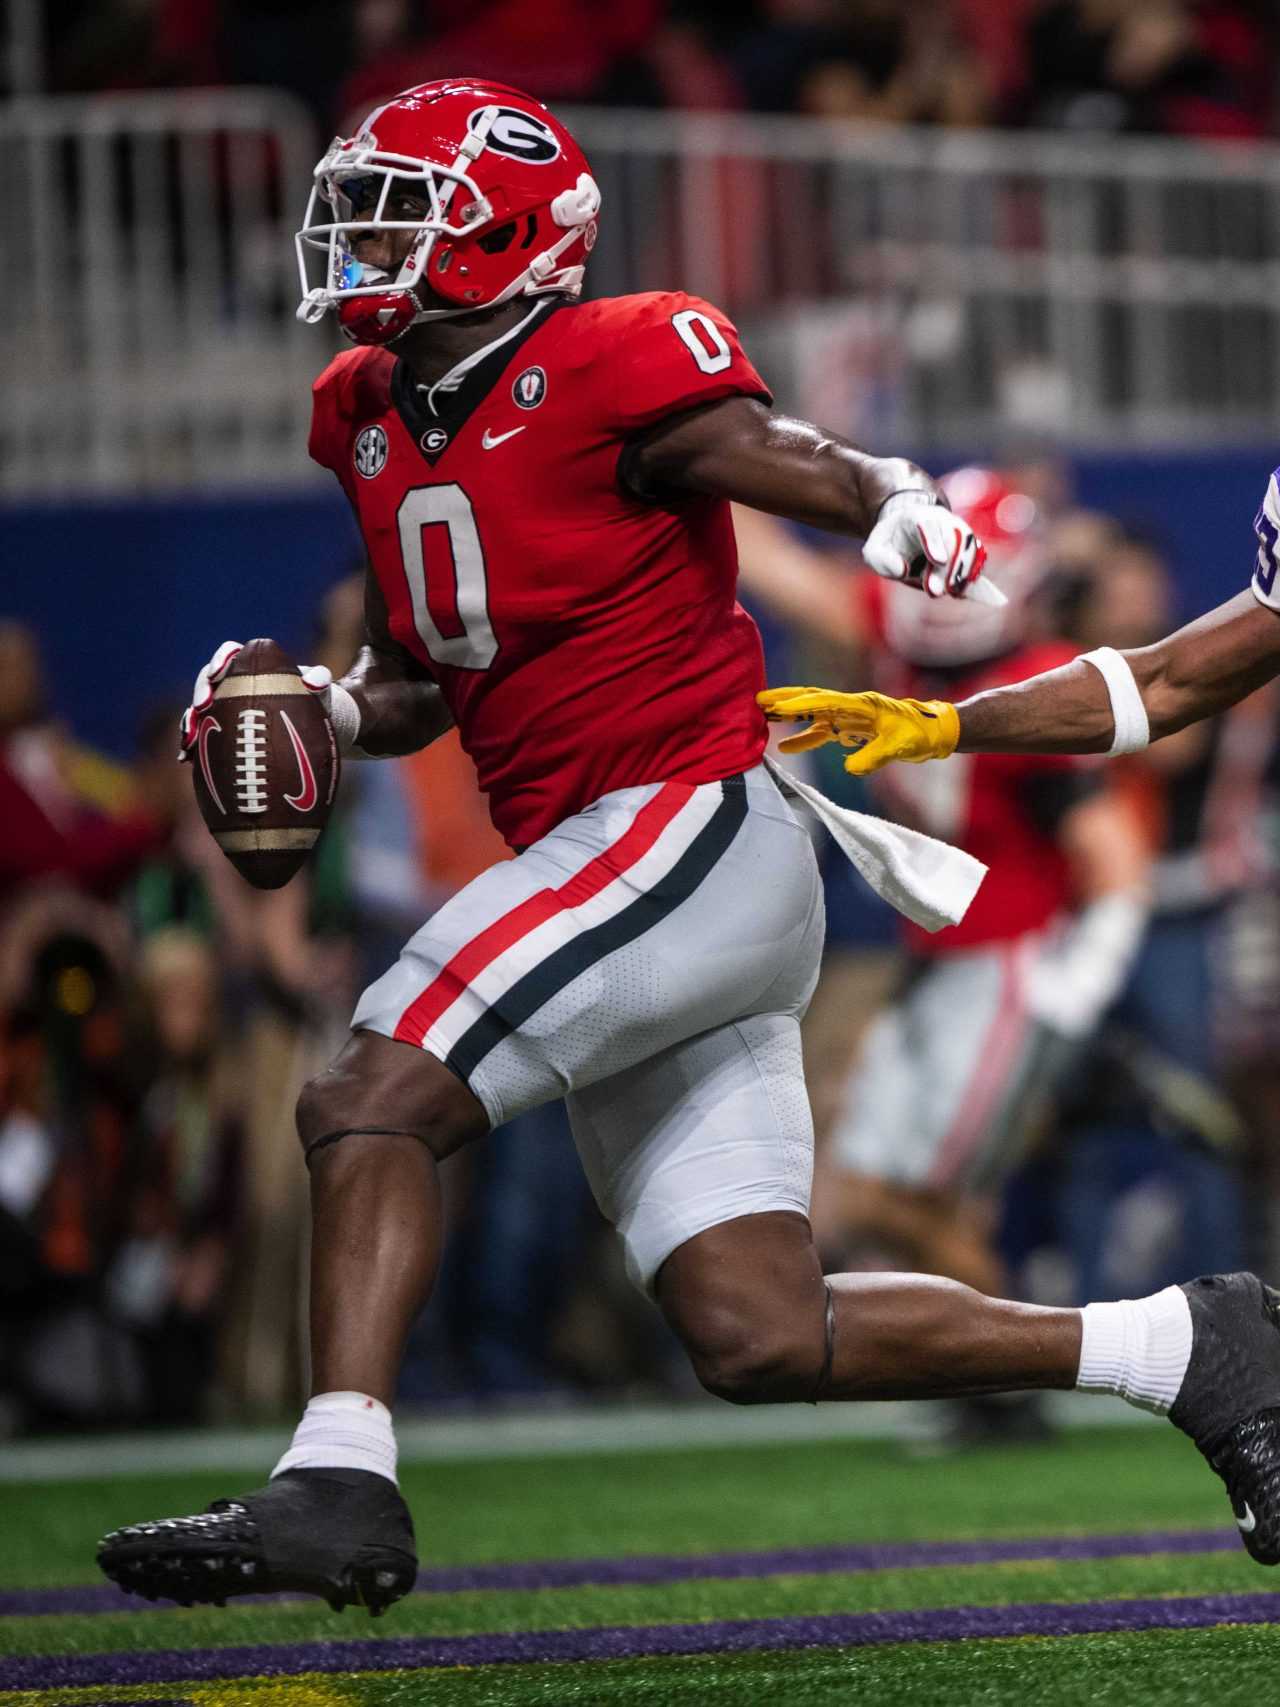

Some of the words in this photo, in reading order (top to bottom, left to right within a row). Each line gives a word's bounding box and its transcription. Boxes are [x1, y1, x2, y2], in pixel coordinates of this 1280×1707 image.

[467, 105, 560, 165] G
[671, 308, 733, 376] 0
[395, 480, 501, 671] 0
